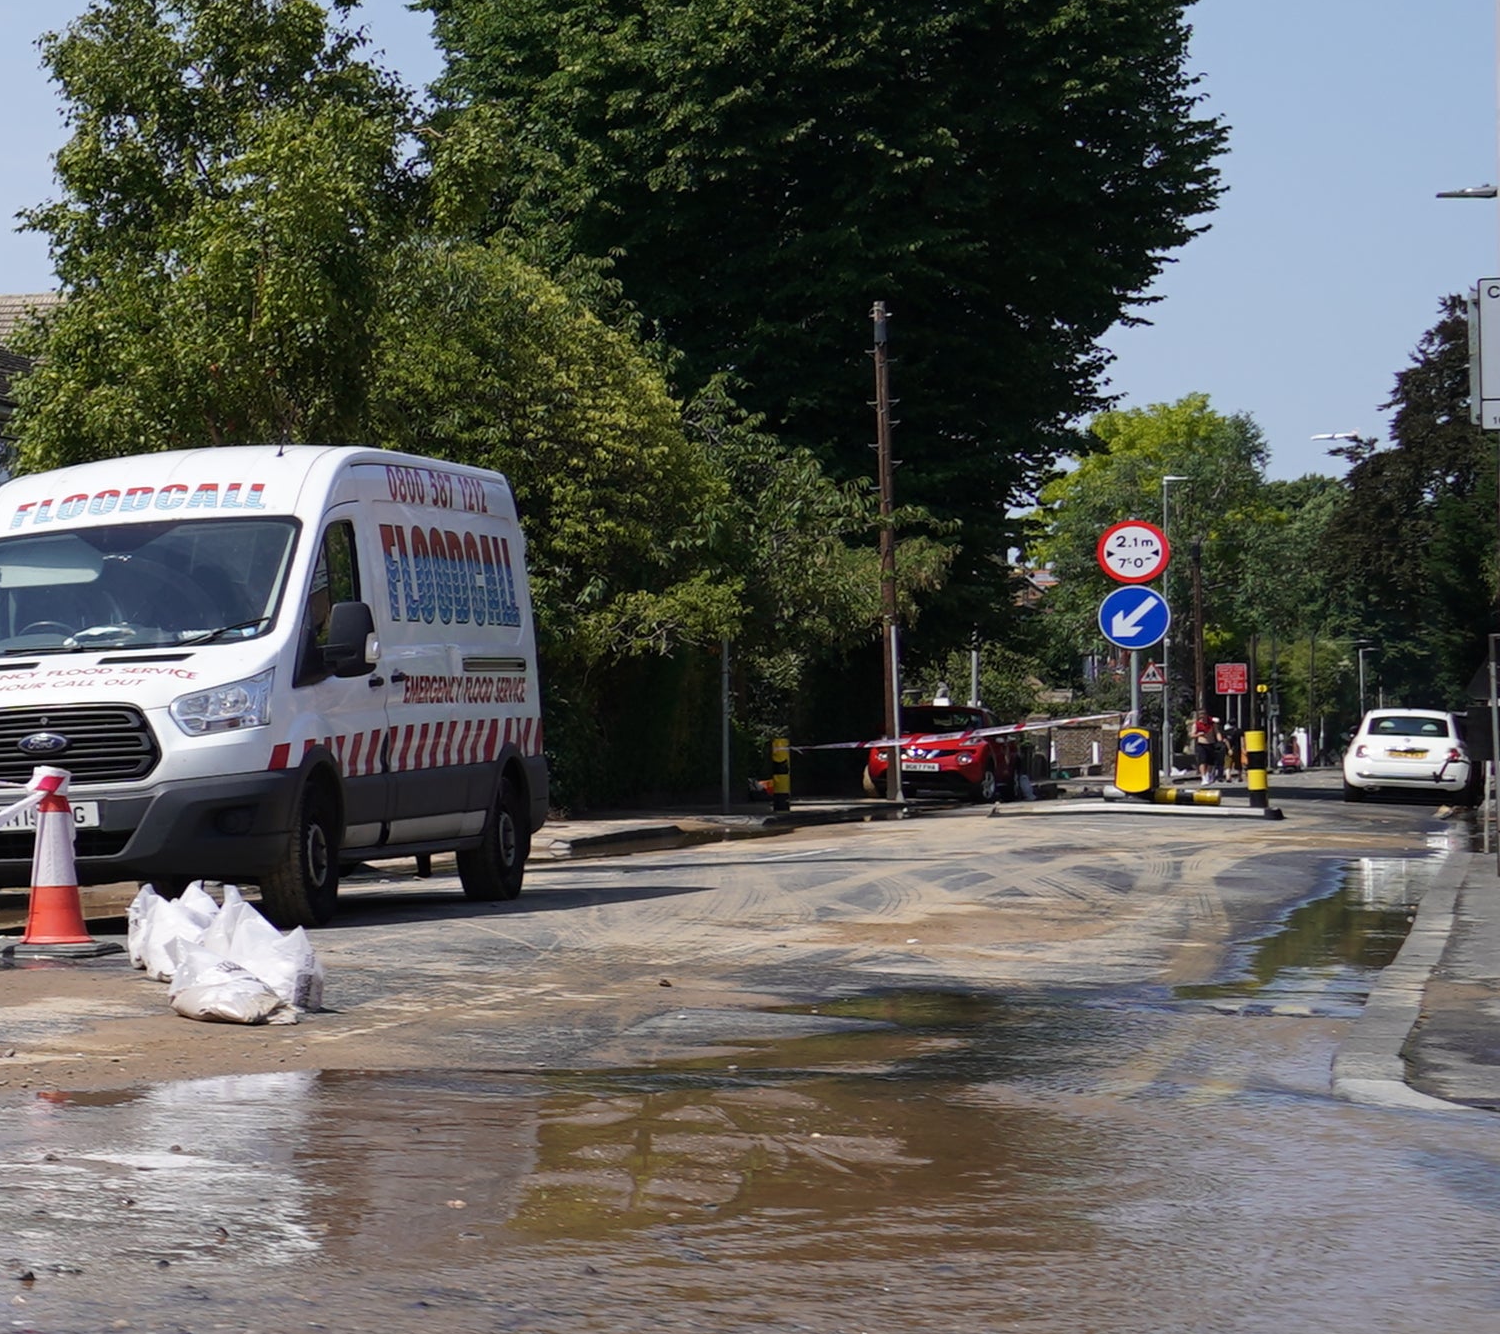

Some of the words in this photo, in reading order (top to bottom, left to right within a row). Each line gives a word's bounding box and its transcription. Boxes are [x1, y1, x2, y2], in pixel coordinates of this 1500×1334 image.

[9, 483, 266, 529] FLOODCALL
[386, 466, 425, 504] 0800
[428, 469, 453, 508] 587
[457, 476, 488, 513] 1212
[379, 524, 522, 627] FLOODCALL
[47, 667, 113, 677] FLOOD
[122, 666, 199, 680] SERVICE
[51, 678, 95, 689] CALL
[104, 678, 147, 686] OUT
[403, 675, 463, 703] EMERGENCY
[464, 677, 494, 703] FLOOD
[494, 677, 526, 703] SERVICE
